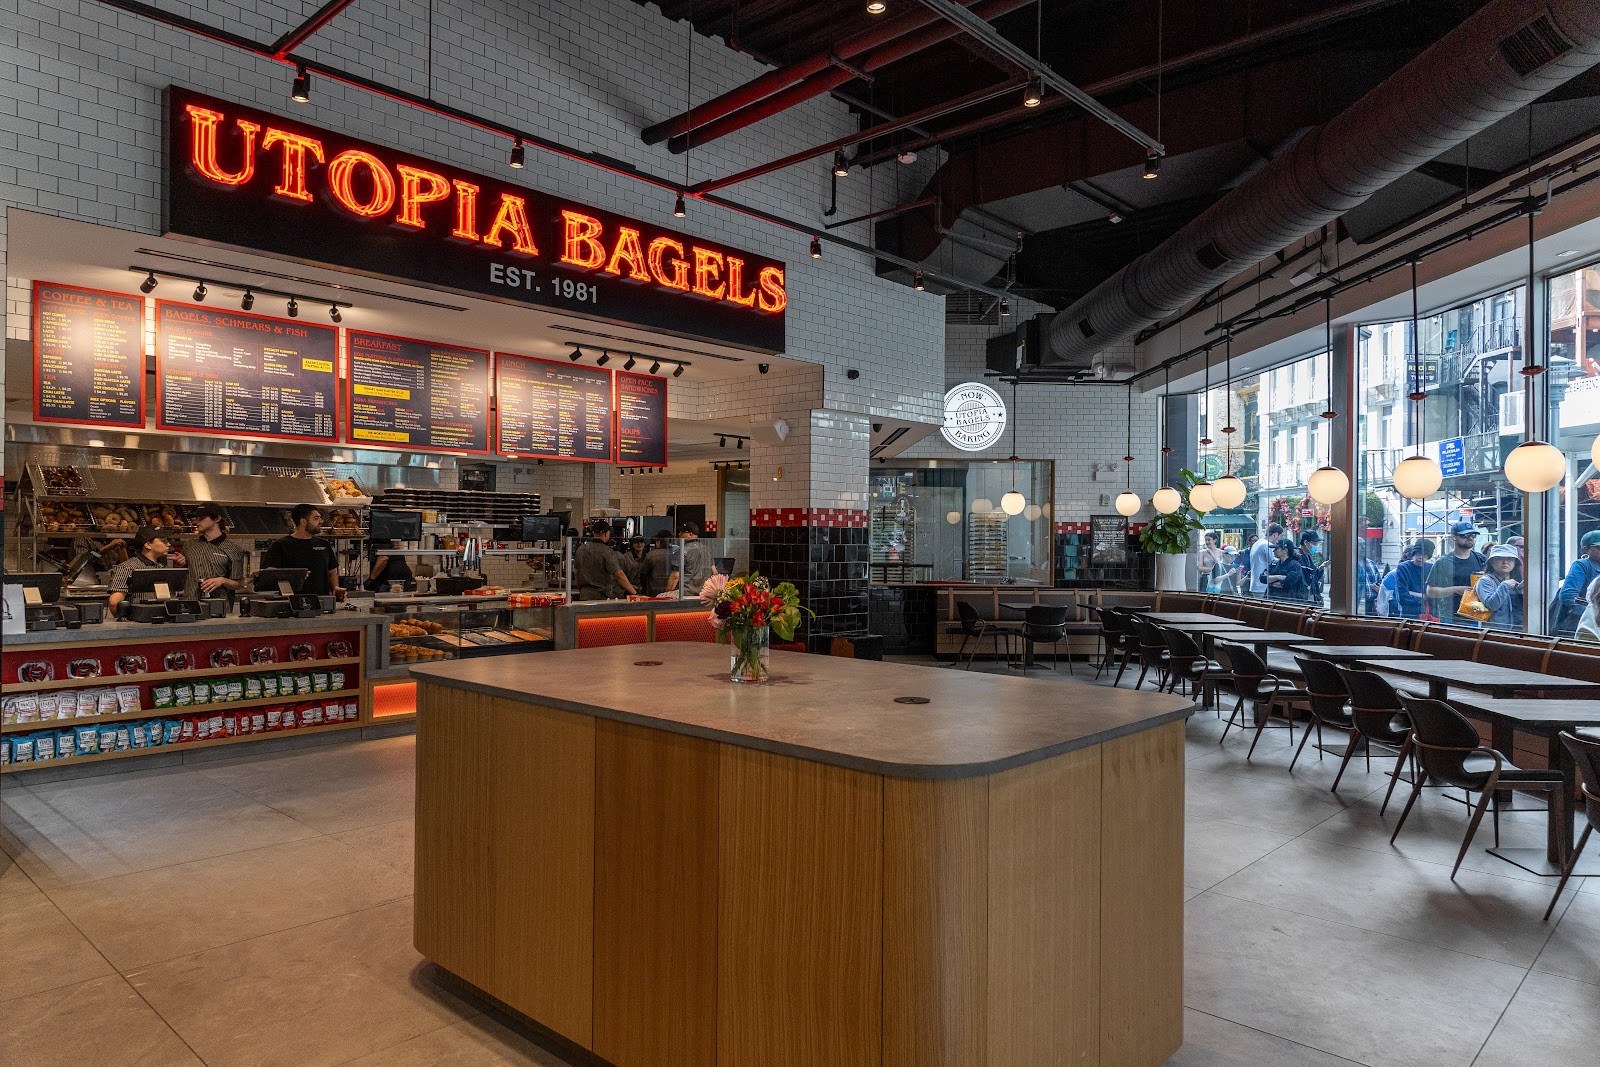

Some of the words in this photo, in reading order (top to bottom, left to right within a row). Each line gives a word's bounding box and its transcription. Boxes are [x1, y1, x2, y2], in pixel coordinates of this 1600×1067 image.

[186, 104, 538, 256] UTOPIA
[560, 210, 787, 313] BAGELS
[490, 262, 540, 292] EST.
[552, 278, 598, 303] 1981
[42, 290, 91, 304] COFFEE
[96, 298, 106, 306] &
[111, 300, 134, 310] TEA
[166, 310, 211, 324] BAGELS,
[216, 317, 270, 332] SCHMEARS
[286, 328, 308, 337] FISH
[354, 338, 402, 350] BREAKFAST
[502, 360, 526, 369] LUNCH
[621, 384, 658, 394] SANDWICHES
[961, 392, 984, 400] NOW
[956, 409, 988, 418] UTOPIA
[956, 415, 991, 425] BAGELS
[955, 430, 991, 442] BAKING
